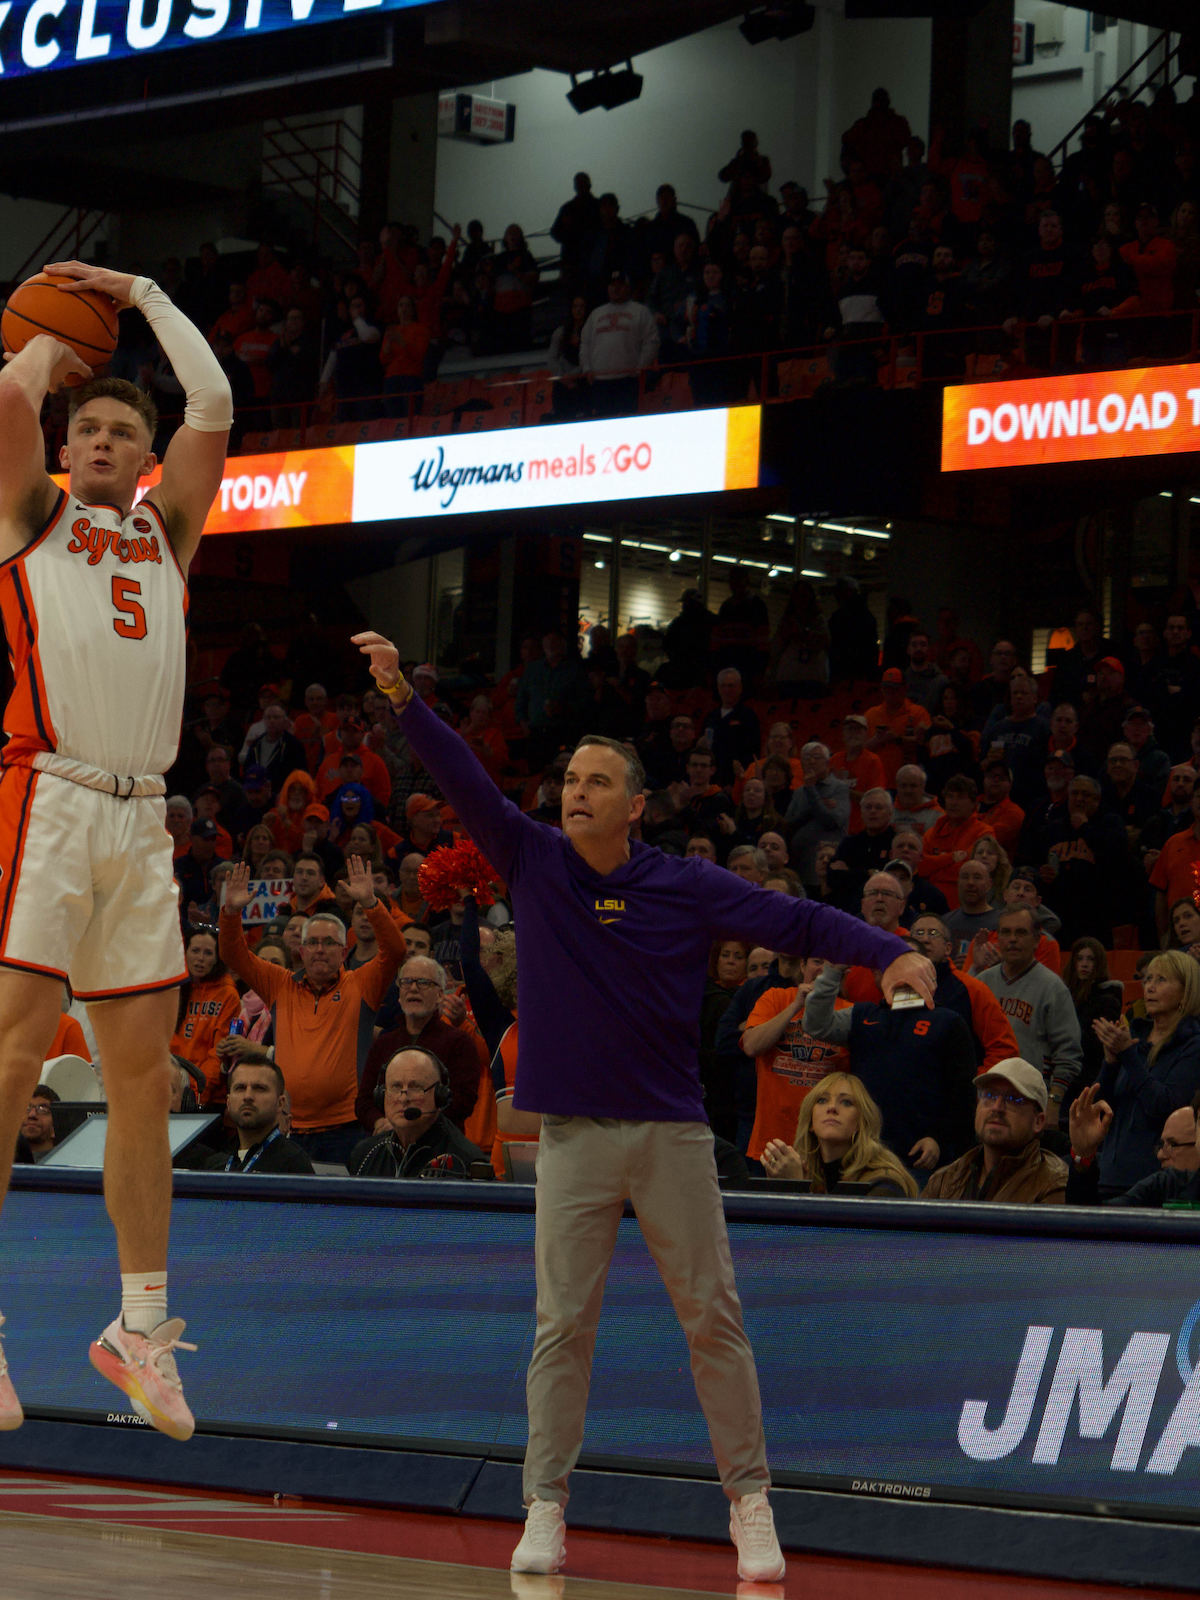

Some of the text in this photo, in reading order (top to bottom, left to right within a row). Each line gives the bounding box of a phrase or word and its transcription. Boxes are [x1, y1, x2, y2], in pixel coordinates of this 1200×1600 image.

[967, 391, 1179, 445] DOWNLOAD
[220, 471, 308, 513] TODAY
[410, 442, 652, 509] Wegmans meals 2GO
[111, 575, 148, 641] 5
[595, 899, 626, 911] LSU
[913, 1019, 932, 1037] S
[851, 1480, 932, 1498] DAKTRONICS
